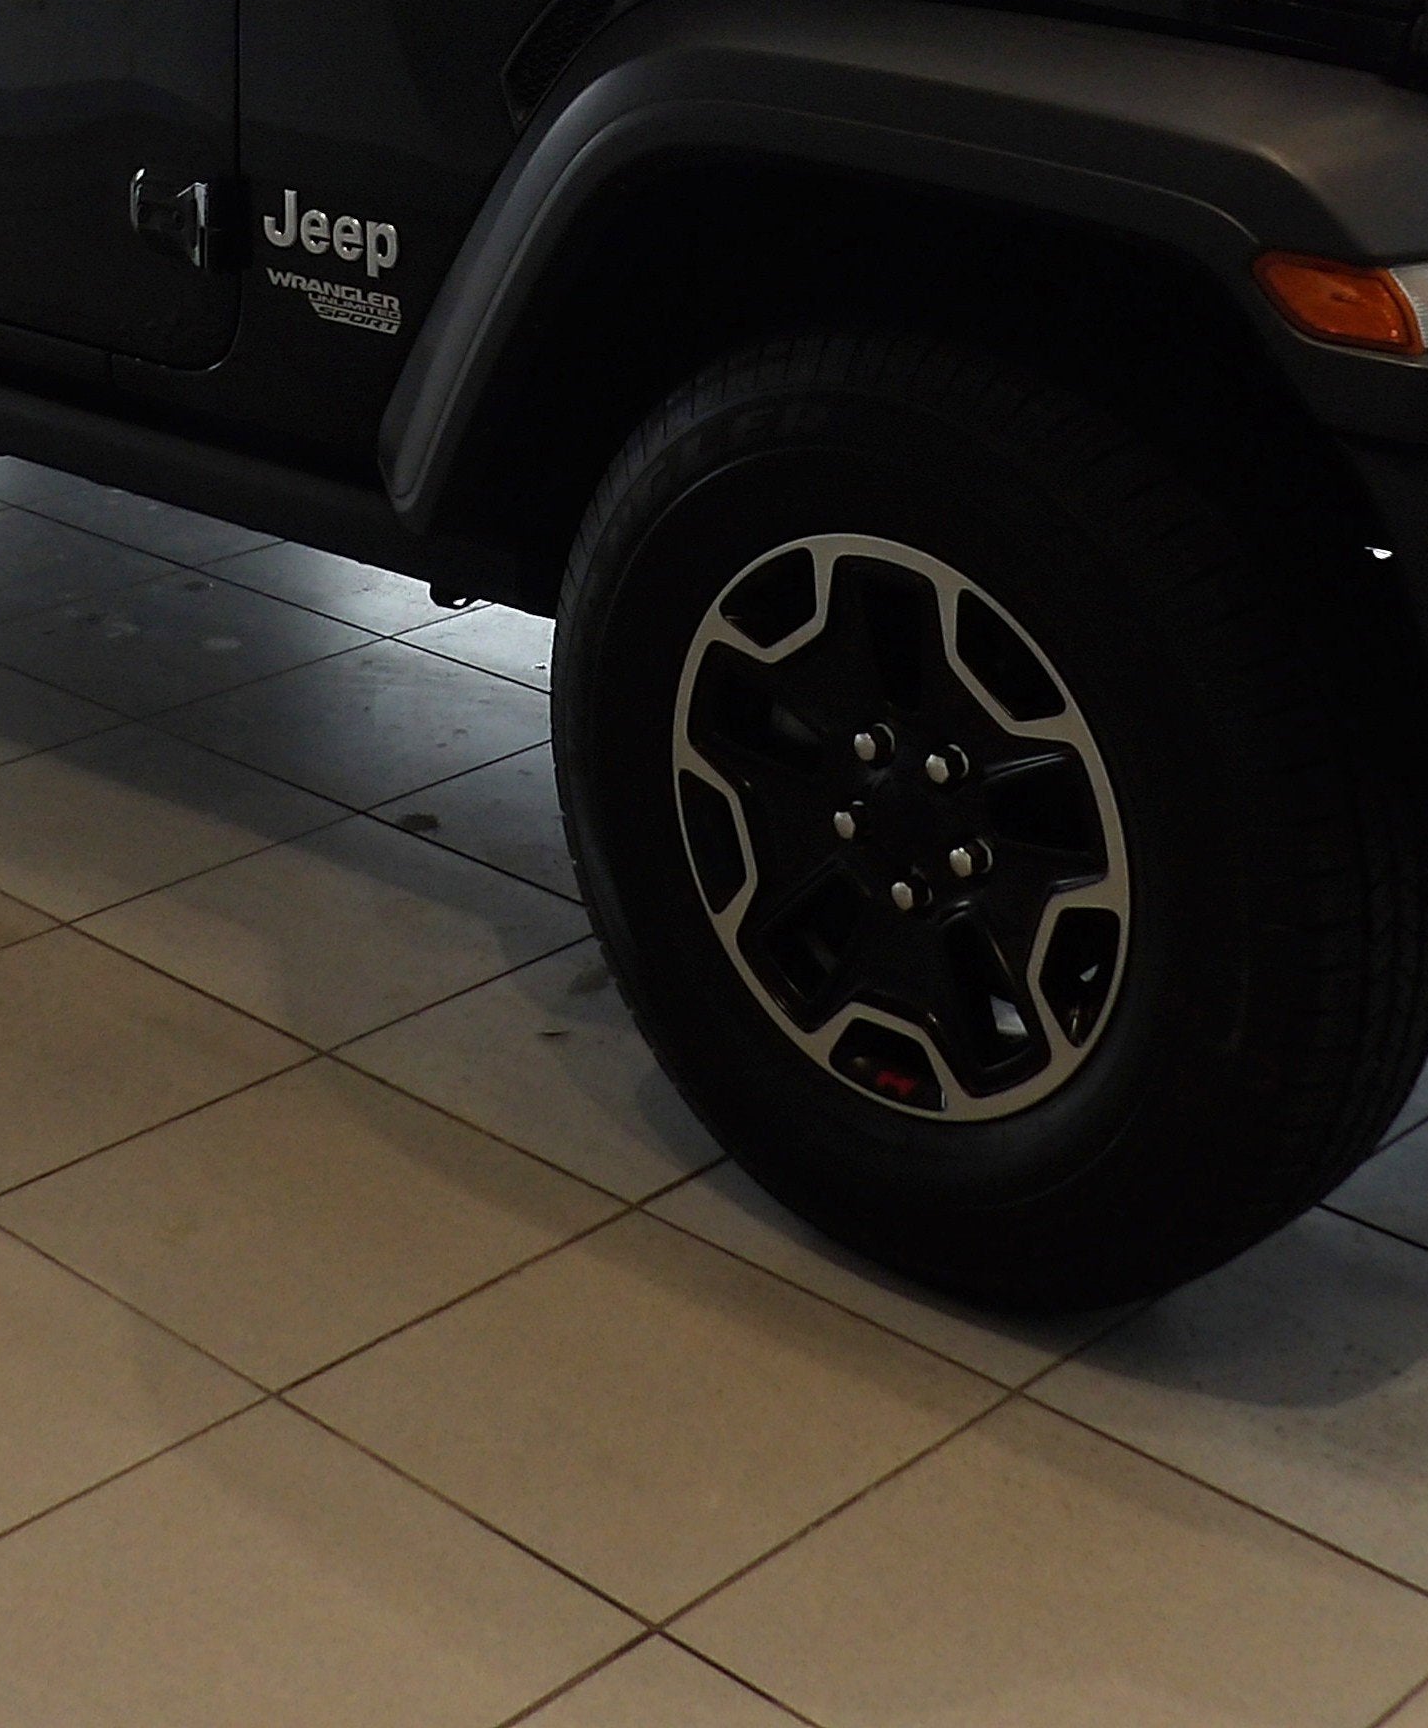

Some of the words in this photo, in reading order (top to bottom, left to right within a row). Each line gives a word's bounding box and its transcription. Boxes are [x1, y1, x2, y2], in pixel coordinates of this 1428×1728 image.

[263, 189, 399, 278] Jeep
[266, 268, 400, 312] WRANGLER
[308, 292, 402, 320] UNLIMITED
[317, 305, 399, 332] SPORT
